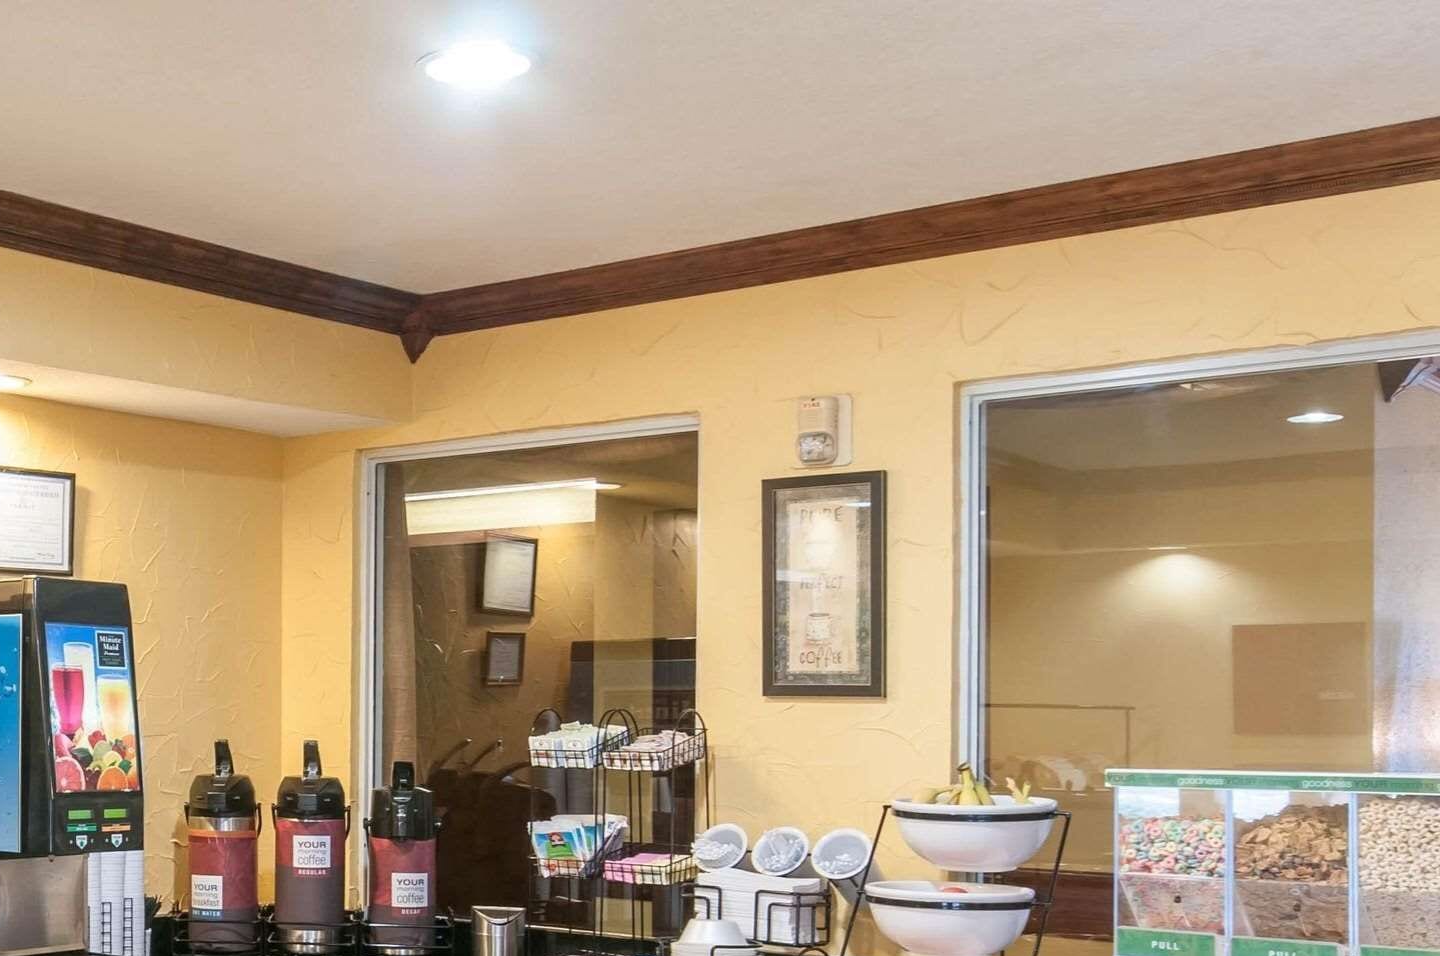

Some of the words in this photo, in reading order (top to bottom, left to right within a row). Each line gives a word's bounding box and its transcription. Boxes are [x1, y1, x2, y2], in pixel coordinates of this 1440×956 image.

[1176, 776, 1226, 786] goodness
[1301, 779, 1353, 789] goodness
[297, 841, 327, 849] YOUR
[297, 854, 327, 865] coffee
[193, 882, 218, 891] YOUR
[396, 878, 425, 886] YOUR
[396, 892, 425, 904] coffee
[1151, 940, 1180, 951] PULL
